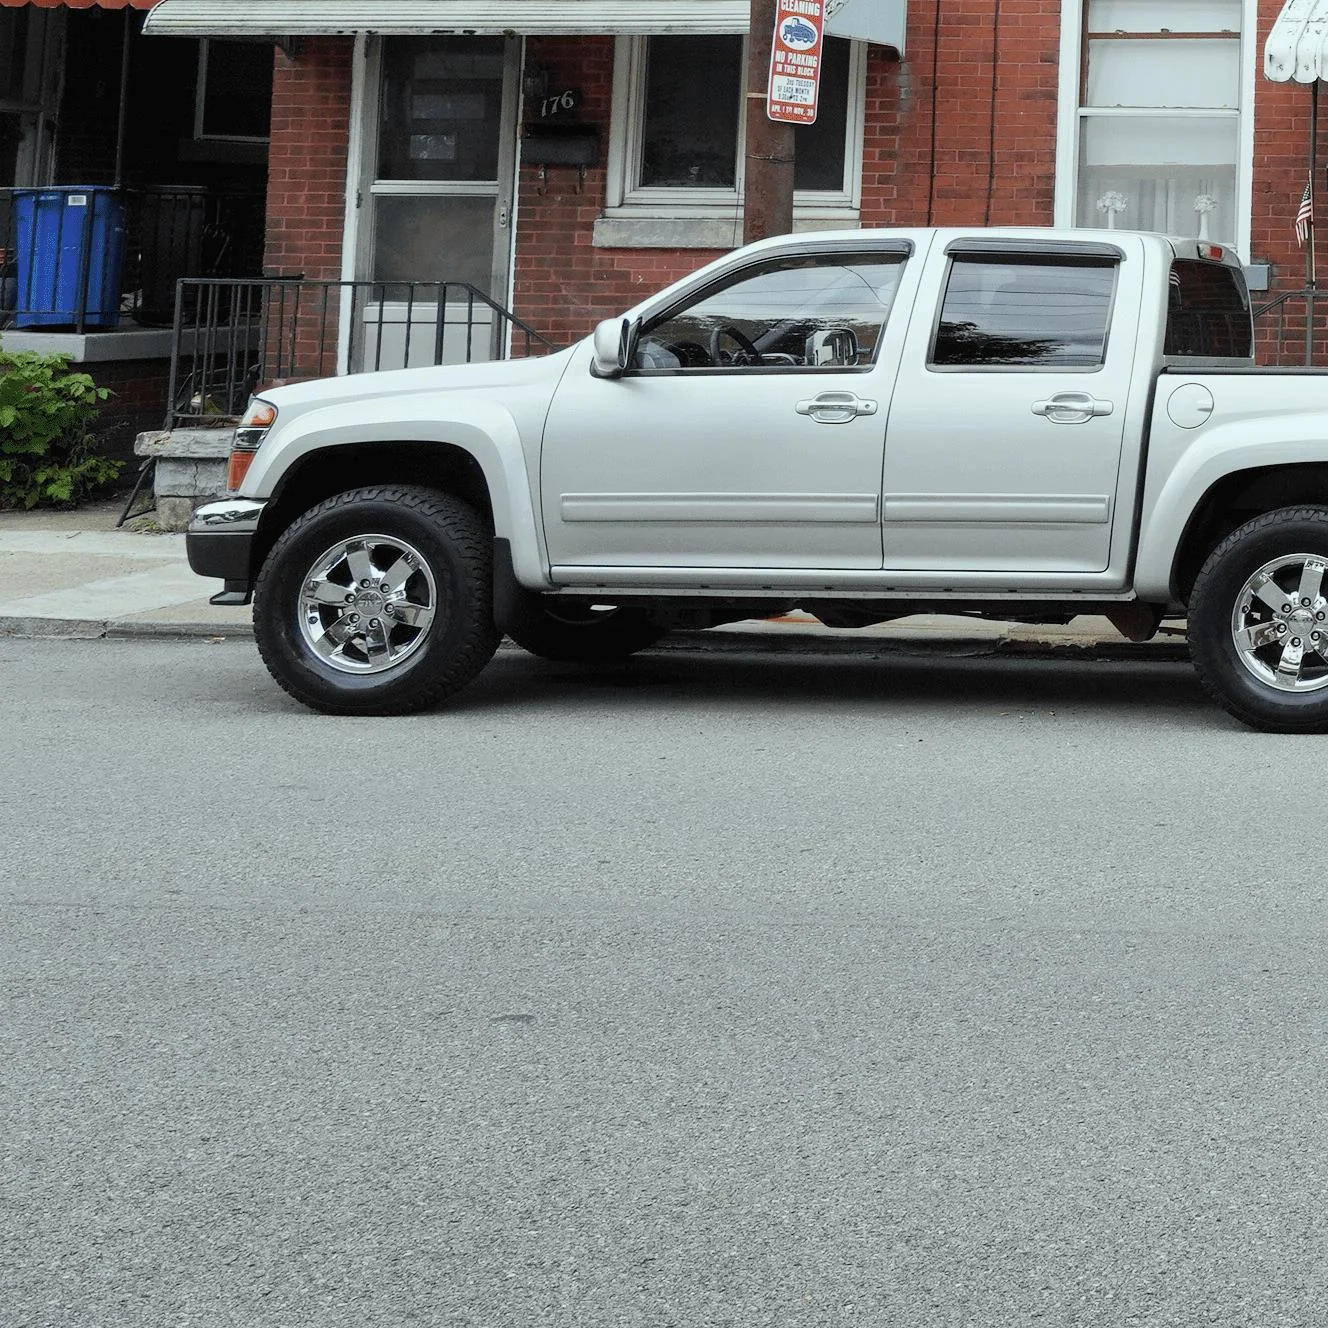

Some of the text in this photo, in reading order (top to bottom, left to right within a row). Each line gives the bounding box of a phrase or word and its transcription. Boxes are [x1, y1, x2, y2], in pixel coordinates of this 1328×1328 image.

[775, 51, 818, 67] NO PARKING
[776, 63, 814, 76] IN THIS BLOCK
[795, 79, 814, 88] TUESDAY
[795, 87, 809, 95] MONTH
[541, 90, 574, 118] 176
